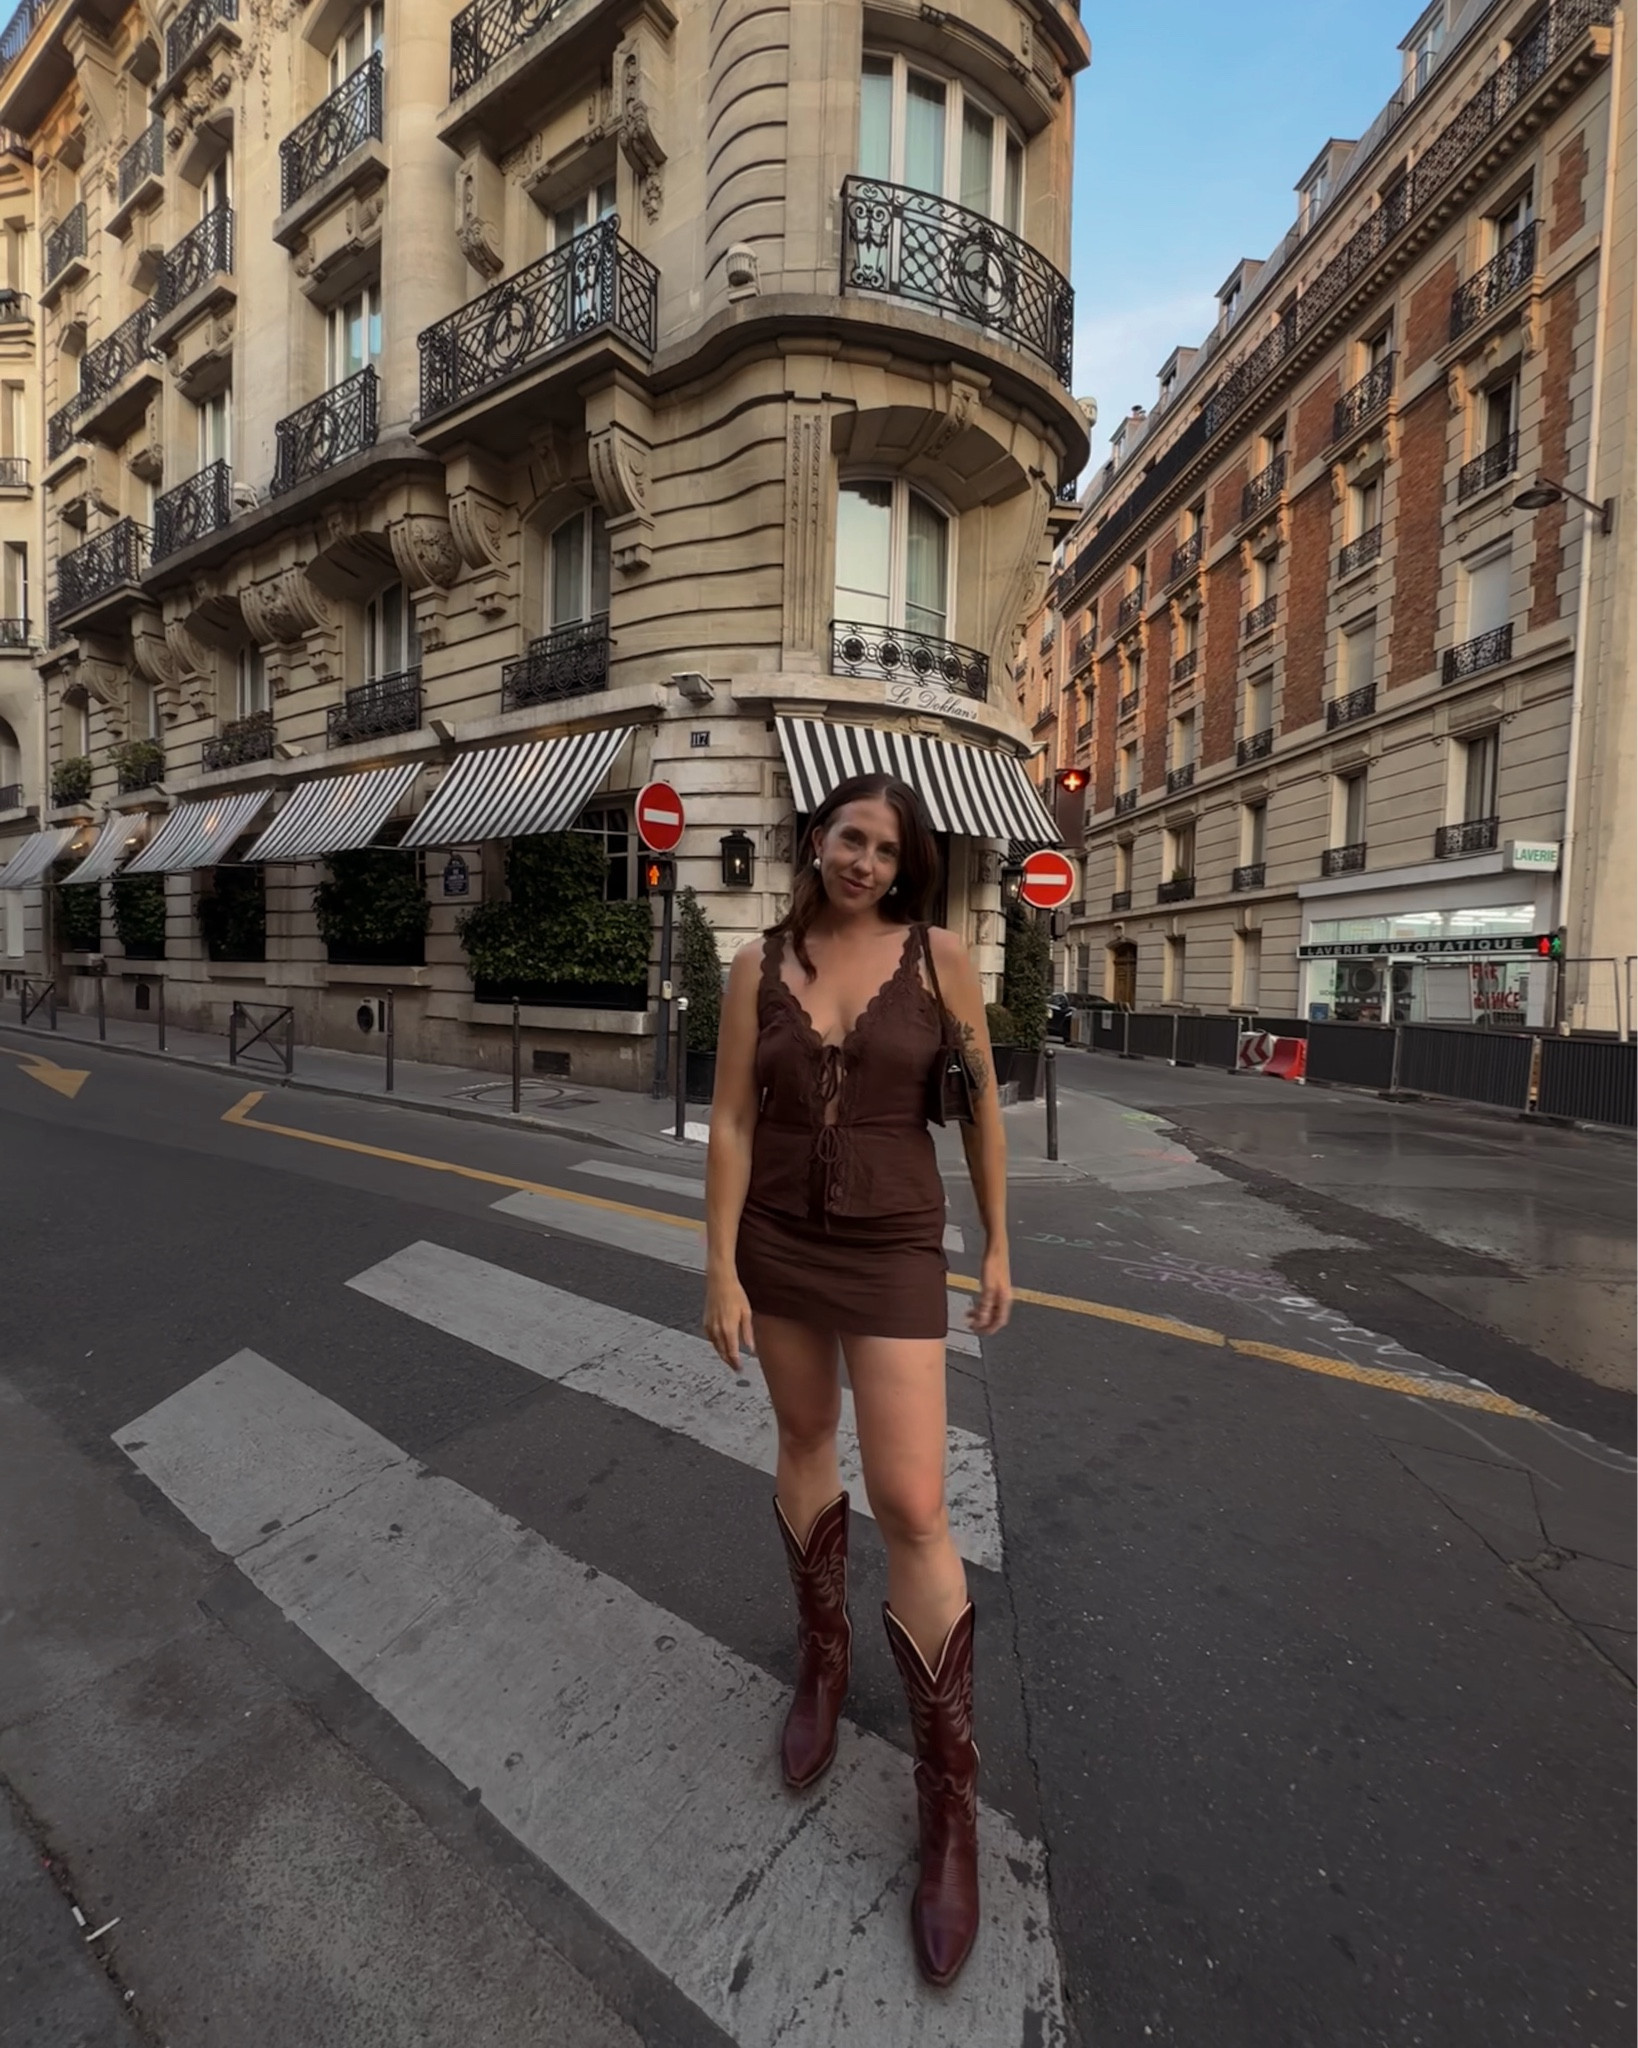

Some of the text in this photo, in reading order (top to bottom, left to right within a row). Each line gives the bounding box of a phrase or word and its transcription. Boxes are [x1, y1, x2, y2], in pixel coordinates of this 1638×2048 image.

[887, 685, 977, 720] Le Dokhan's
[692, 733, 707, 746] 117
[1515, 848, 1557, 862] LAVERIE
[1307, 938, 1524, 955] LAVERIE AUTOMATIQUE
